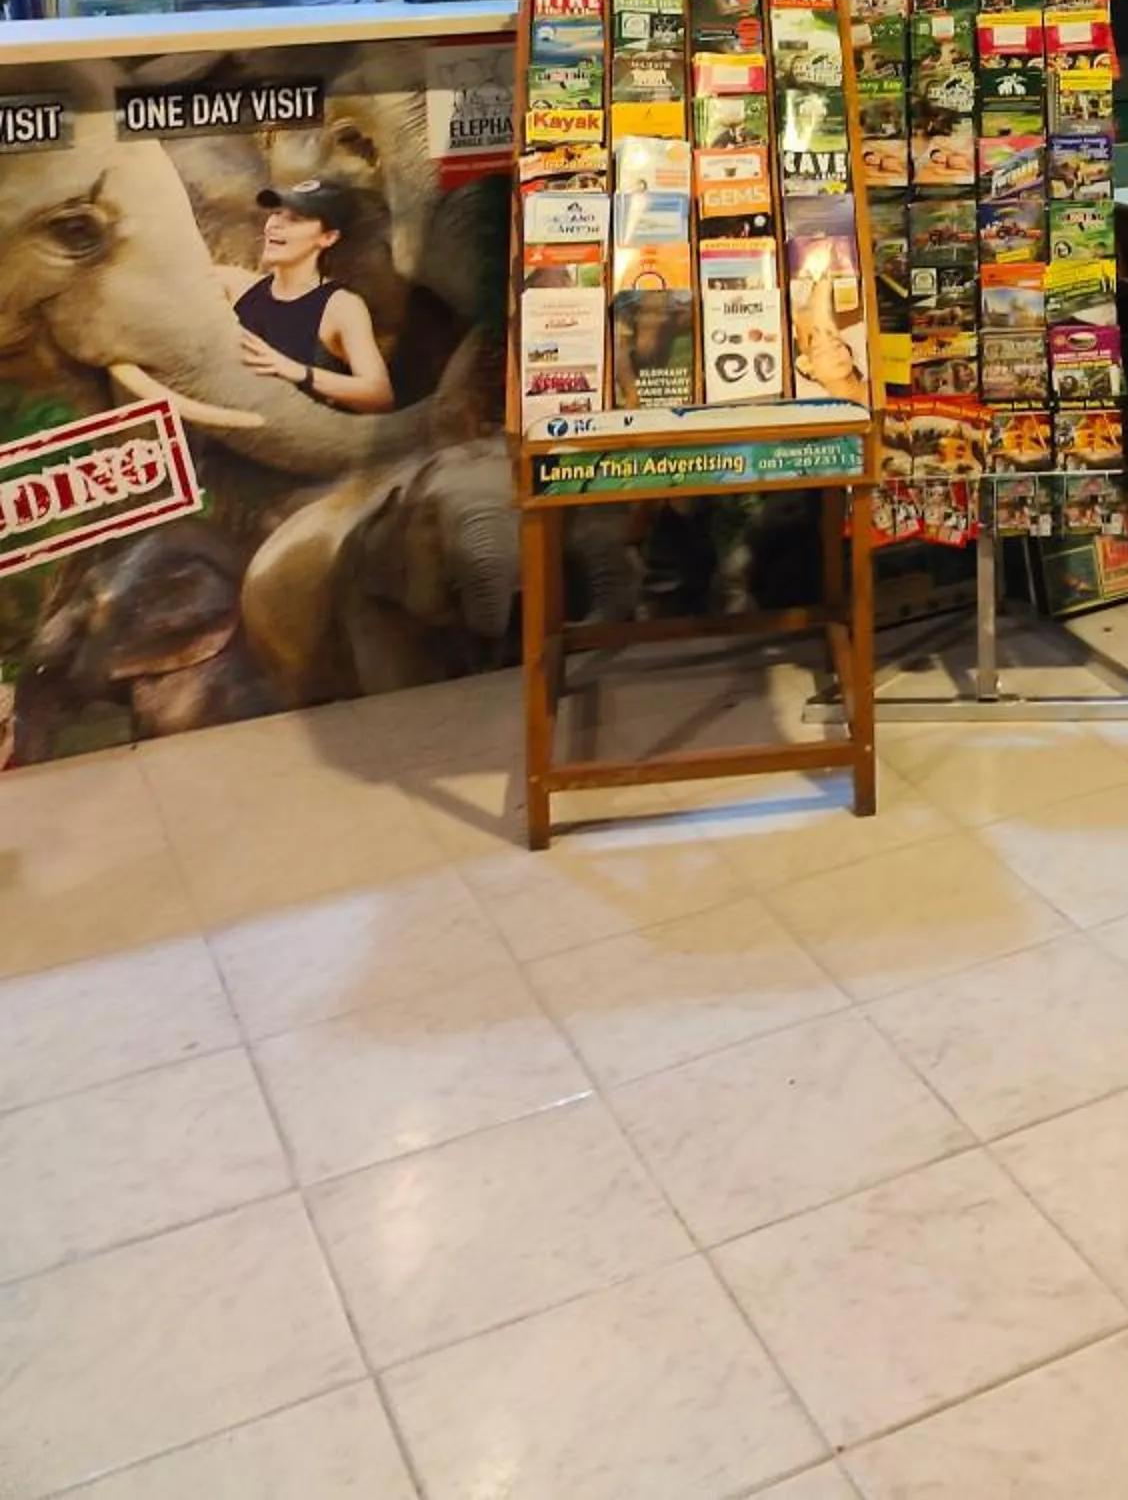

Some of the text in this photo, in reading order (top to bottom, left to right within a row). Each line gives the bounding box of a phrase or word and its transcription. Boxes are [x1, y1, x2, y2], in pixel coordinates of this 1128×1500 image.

[127, 87, 319, 131] ONE DAY VISIT
[449, 118, 514, 138] ELEPHA
[533, 112, 600, 132] Kayak
[785, 151, 847, 174] CAVE
[703, 185, 766, 207] GEMS
[540, 453, 745, 482] Lanna Thai Advertising
